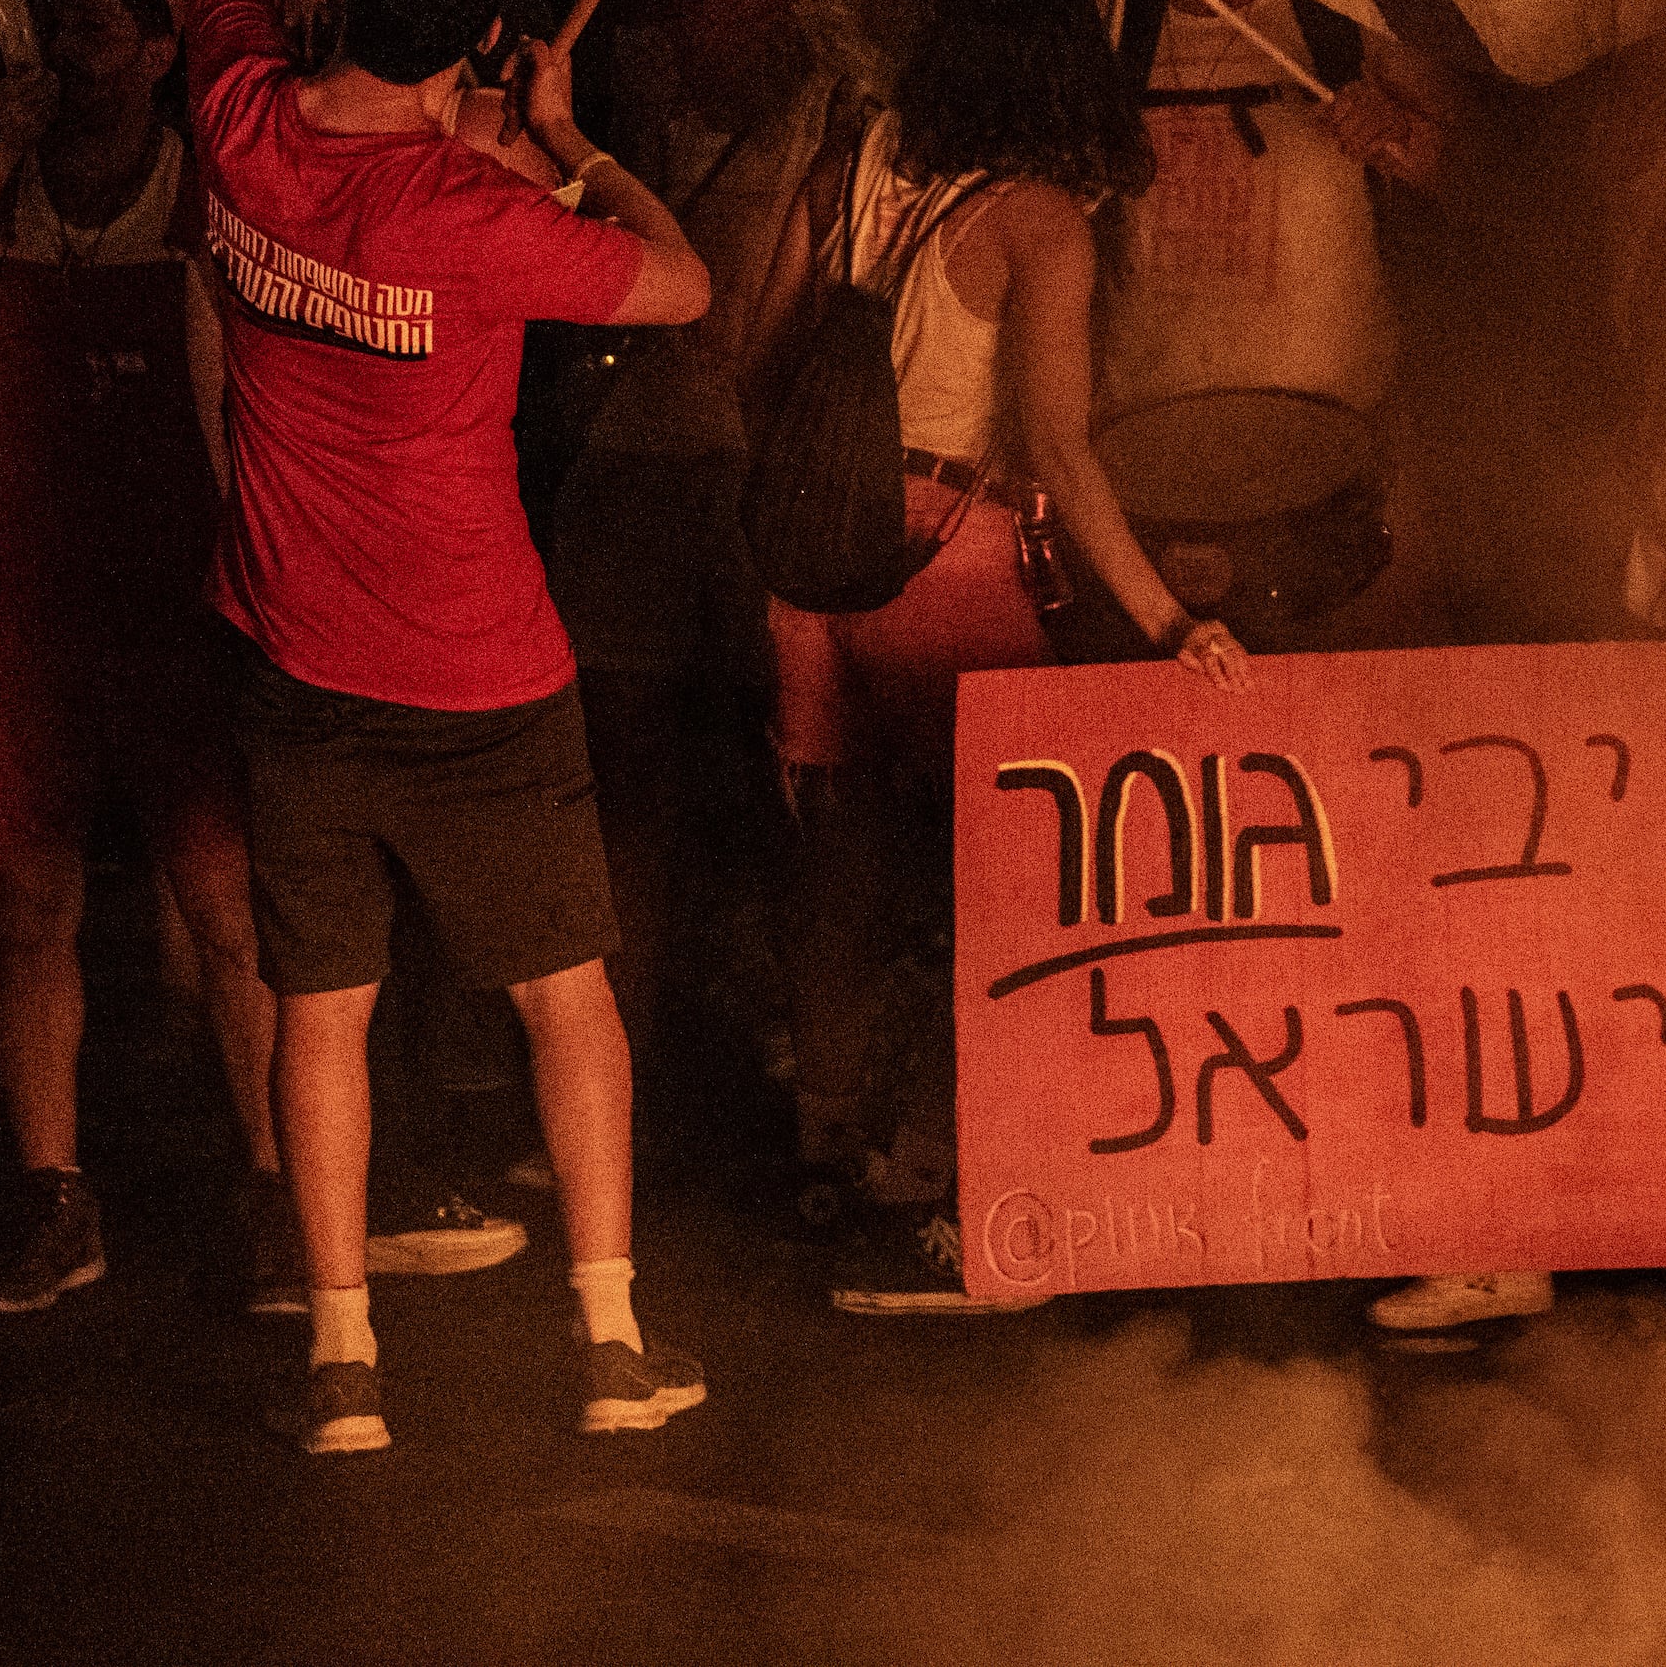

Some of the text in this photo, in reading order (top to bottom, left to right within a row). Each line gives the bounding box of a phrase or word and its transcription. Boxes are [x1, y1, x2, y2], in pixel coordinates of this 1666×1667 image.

[271, 240, 369, 312] המשפחות
[375, 282, 433, 317] מטה
[304, 289, 433, 355] החטופים
[994, 750, 1340, 927] גומר
